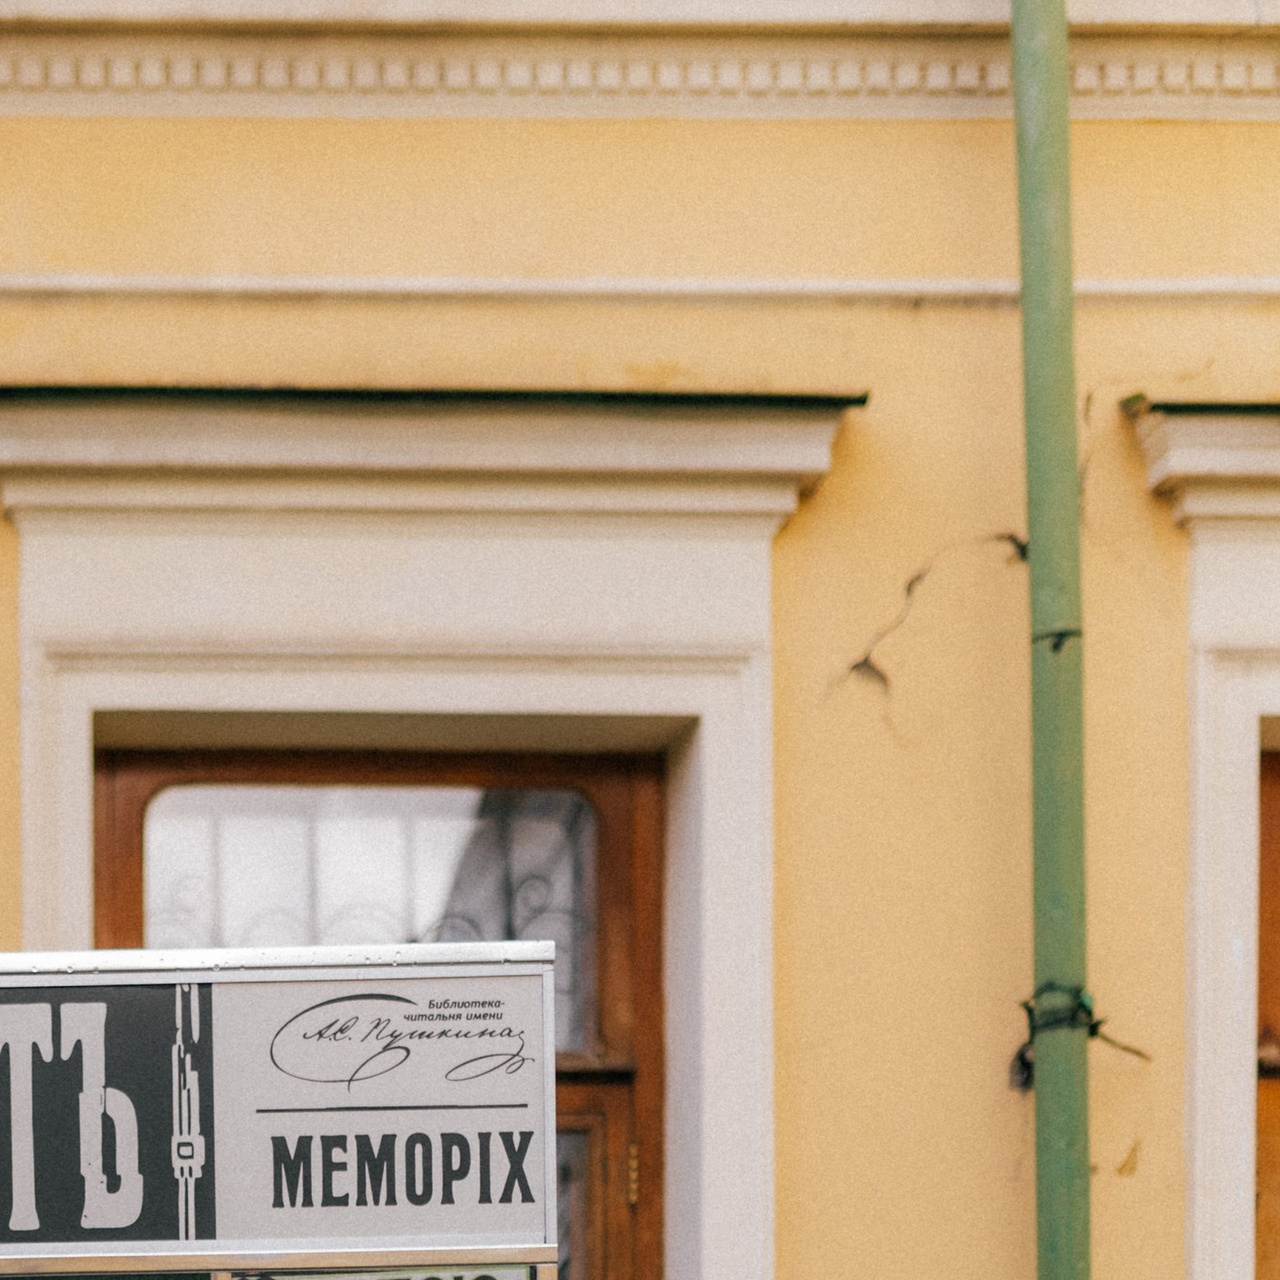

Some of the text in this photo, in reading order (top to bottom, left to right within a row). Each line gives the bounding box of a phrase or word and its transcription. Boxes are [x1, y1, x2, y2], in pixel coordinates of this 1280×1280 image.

[428, 999, 505, 1010] Библиотека-
[403, 1011, 503, 1023] читальня имени
